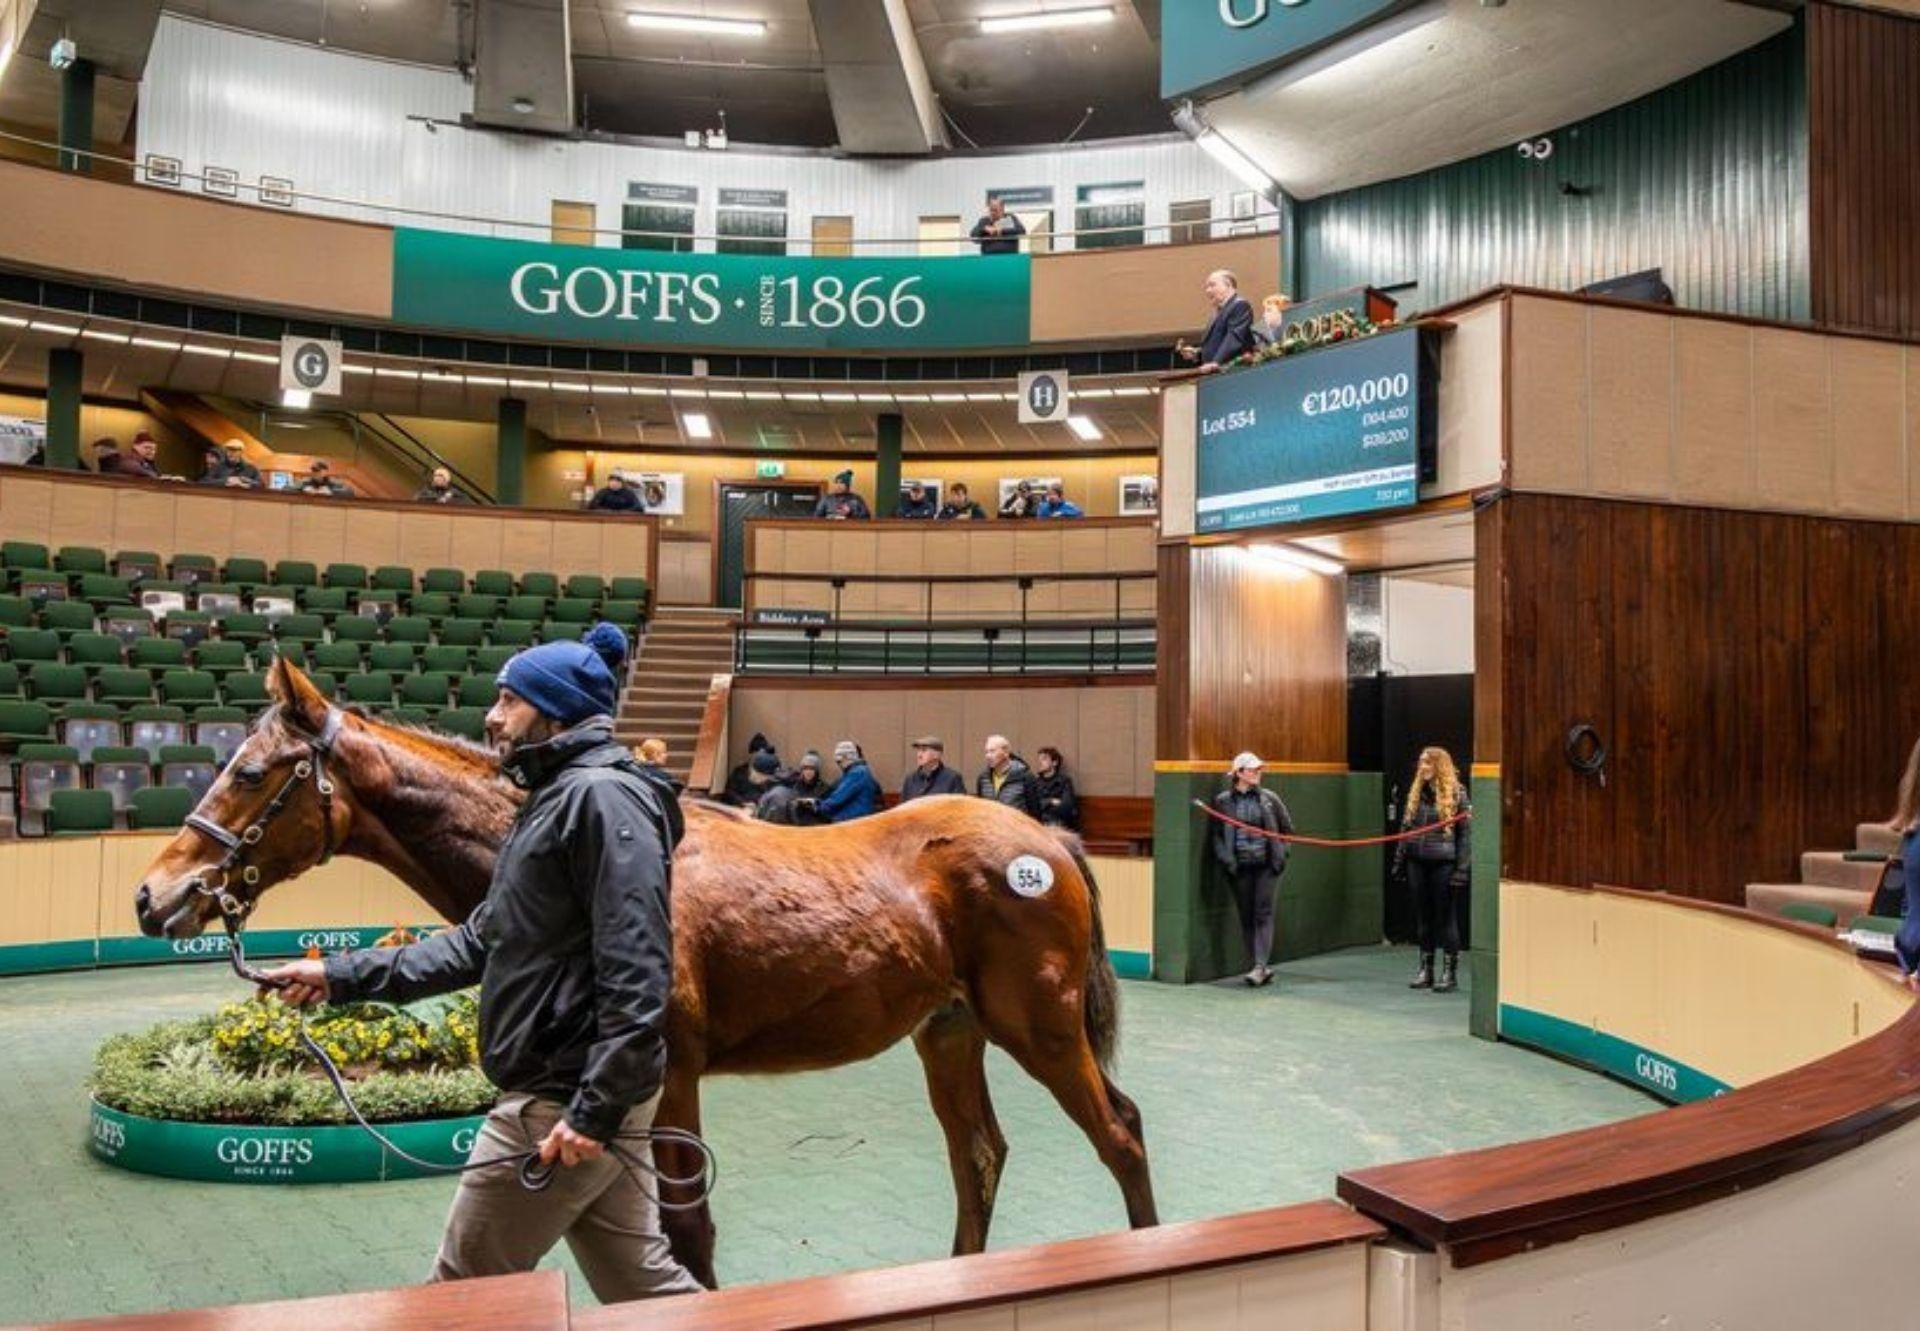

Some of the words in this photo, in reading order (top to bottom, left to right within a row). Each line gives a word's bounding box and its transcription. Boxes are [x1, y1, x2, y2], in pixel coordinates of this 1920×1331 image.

[509, 262, 722, 325] GOFFS
[759, 275, 775, 327] SINCE
[780, 275, 926, 328] 1866
[299, 352, 323, 376] G
[1033, 386, 1054, 407] H
[1302, 372, 1409, 416] €120,000
[1203, 417, 1226, 436] Lot
[1227, 408, 1256, 430] 554
[758, 612, 799, 625] Bidders
[1018, 868, 1043, 889] 554
[297, 931, 360, 949] GOFFS
[1636, 1053, 1677, 1091] GOFFS
[217, 1136, 313, 1163] GOFFS
